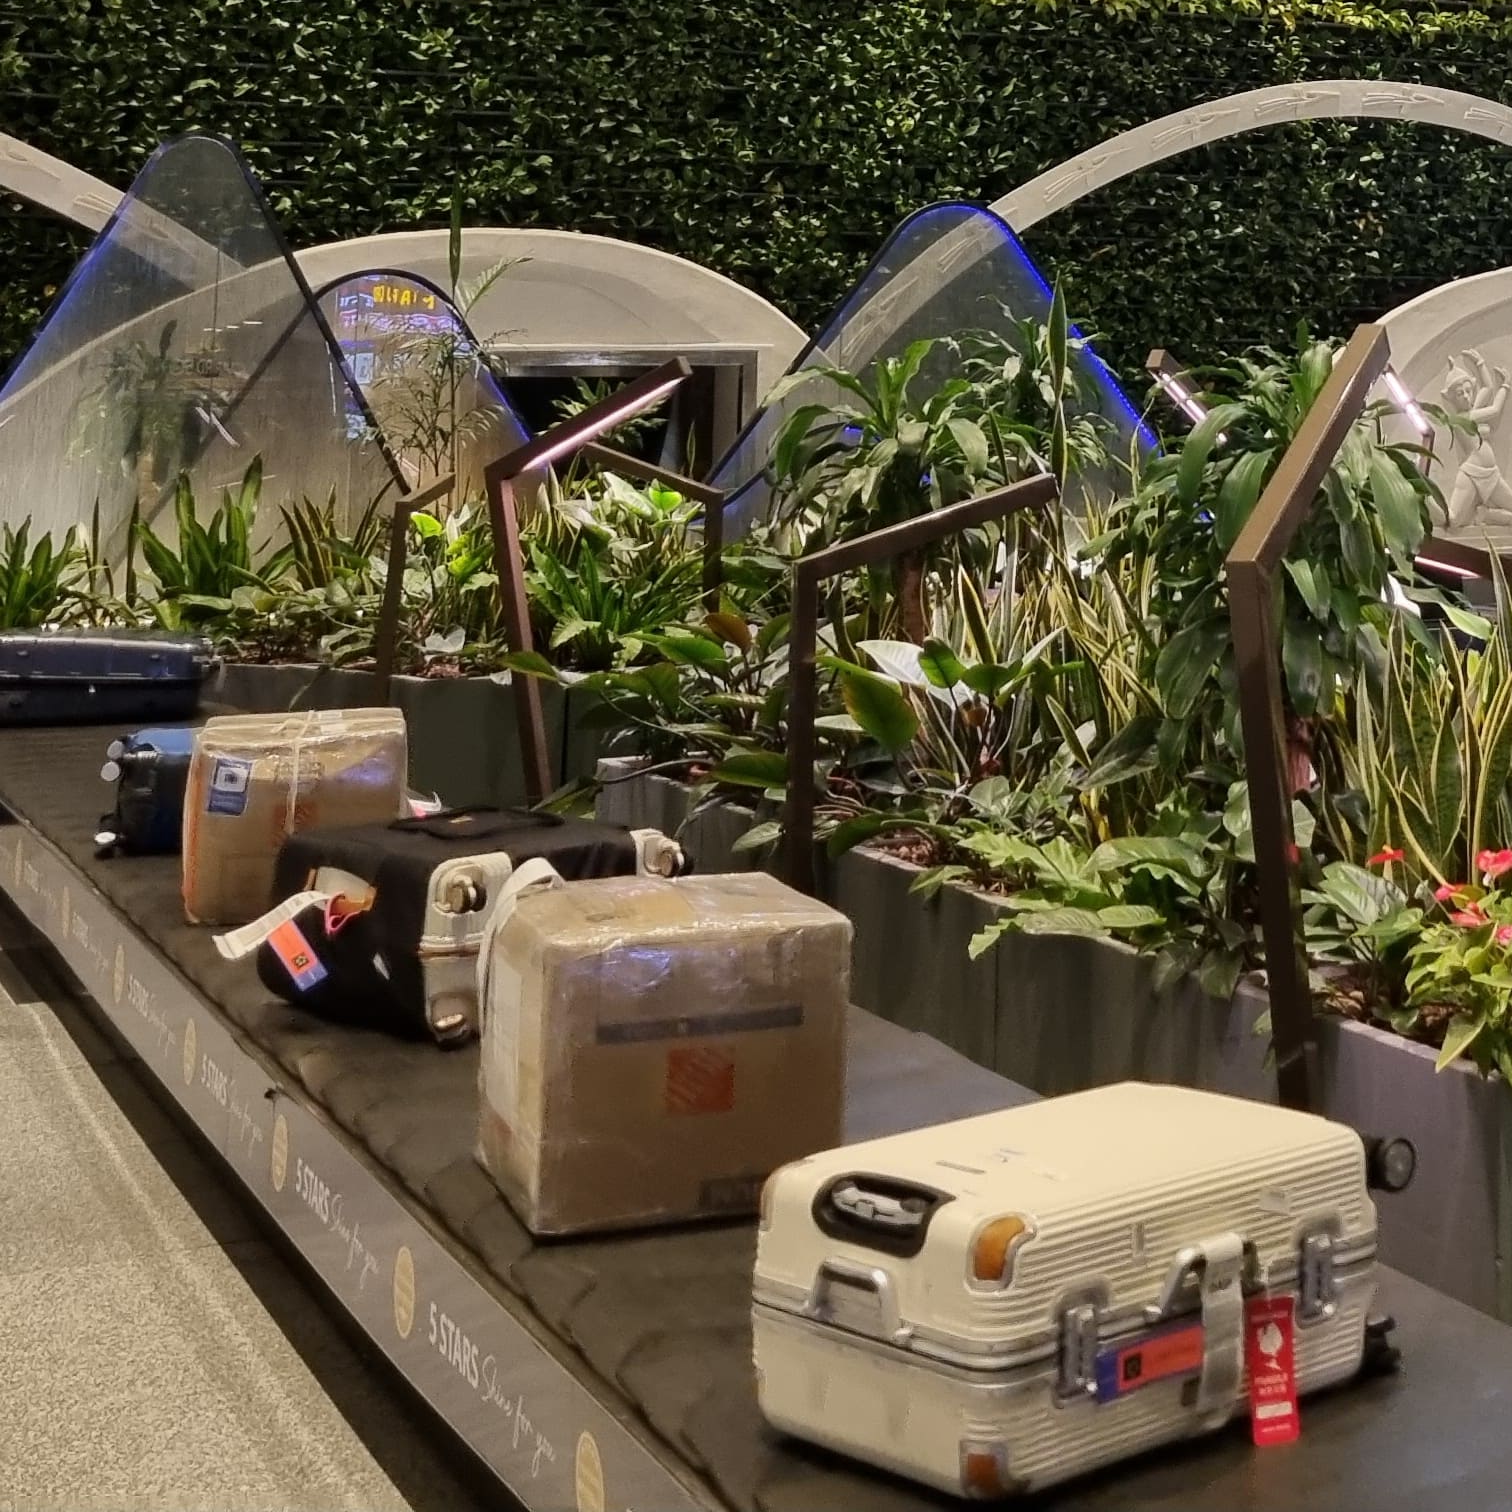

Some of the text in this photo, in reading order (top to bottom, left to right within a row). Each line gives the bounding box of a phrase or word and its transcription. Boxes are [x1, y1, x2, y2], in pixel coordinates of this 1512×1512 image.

[296, 1157, 303, 1192] 5
[302, 1165, 331, 1224] STARS
[429, 1301, 438, 1346] 5
[439, 1313, 480, 1389] STARS
